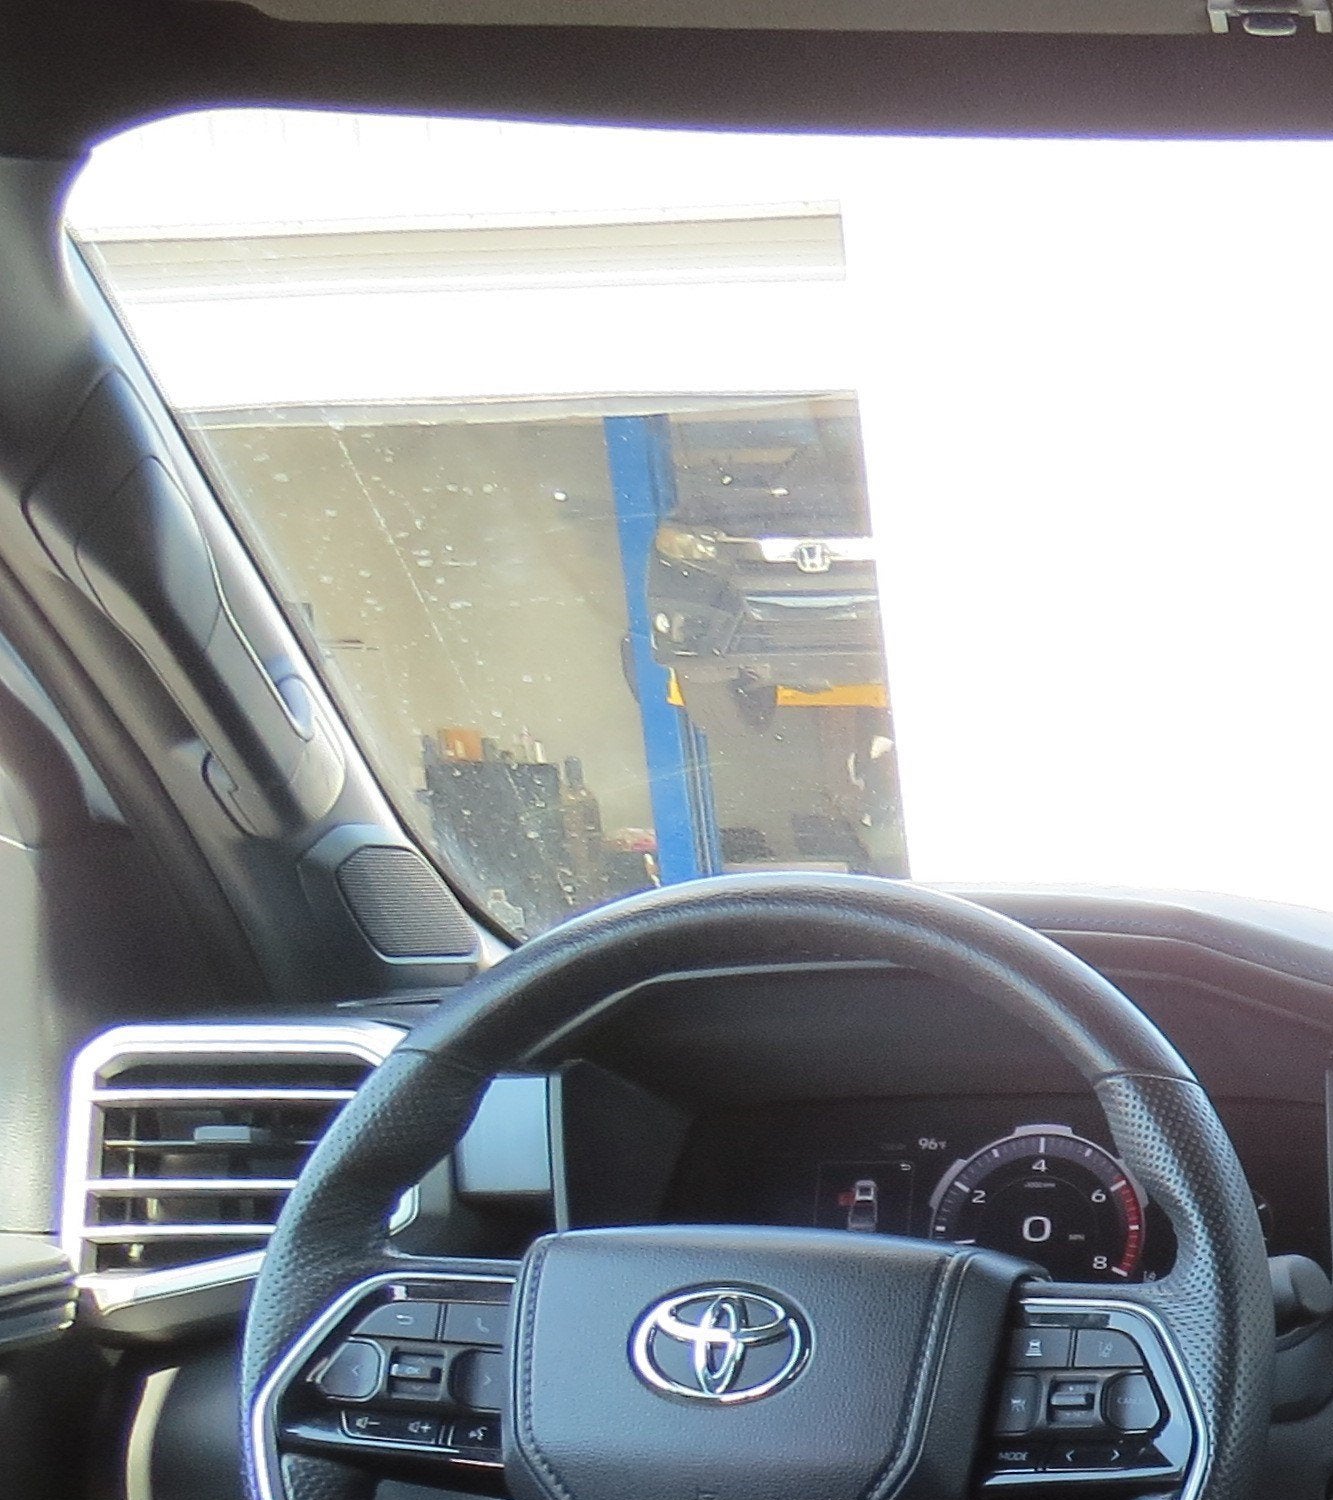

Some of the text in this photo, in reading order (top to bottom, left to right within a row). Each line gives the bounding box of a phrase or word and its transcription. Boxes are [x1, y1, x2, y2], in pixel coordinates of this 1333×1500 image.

[1032, 1159, 1047, 1172] 4
[972, 1190, 986, 1203] 2
[1091, 1189, 1106, 1203] 6
[1022, 1216, 1051, 1242] 0
[1092, 1255, 1108, 1270] 8
